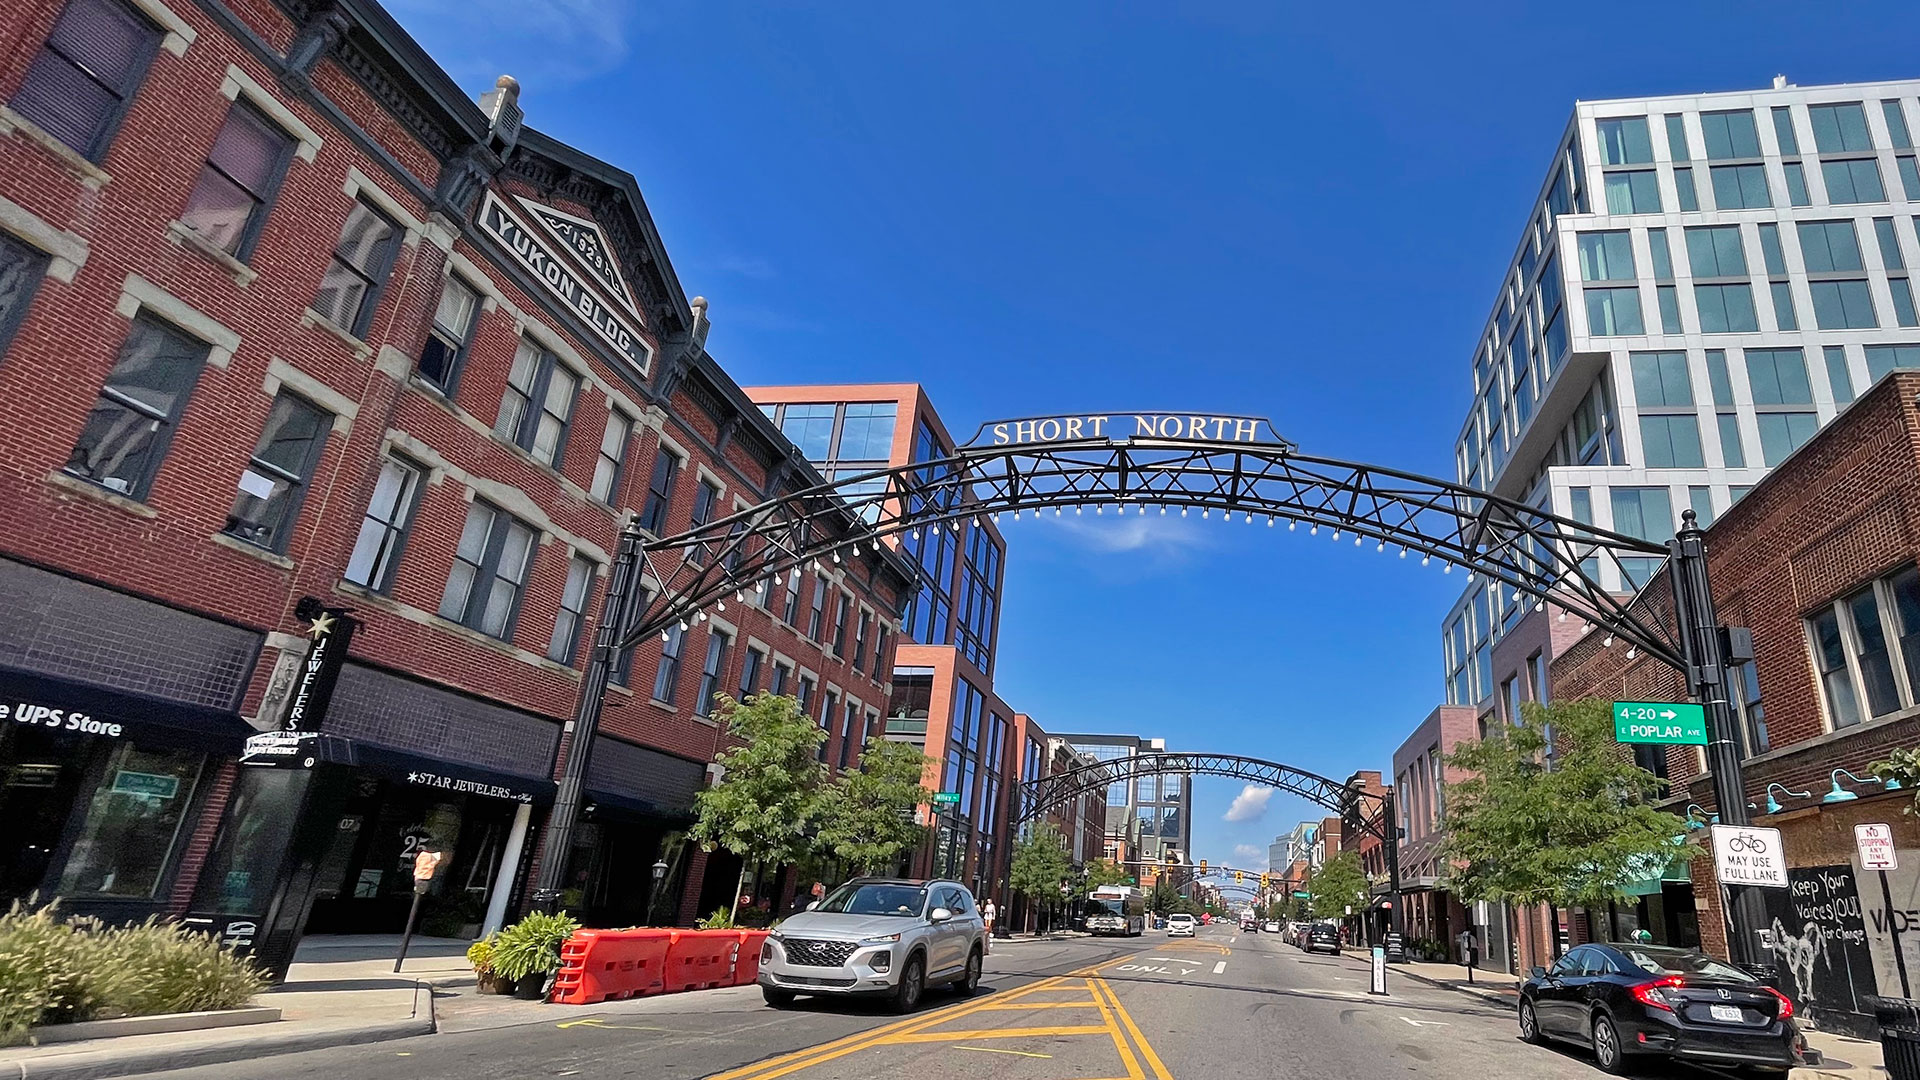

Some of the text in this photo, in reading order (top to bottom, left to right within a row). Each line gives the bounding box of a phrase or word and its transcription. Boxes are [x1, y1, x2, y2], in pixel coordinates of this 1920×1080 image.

[571, 231, 602, 269] 1929
[497, 210, 636, 358] YUKON BLDG.
[993, 415, 1259, 446] SHORT NORTH
[285, 637, 327, 731] JEWELERS
[14, 703, 64, 727] UPS
[65, 712, 122, 737] Store
[1620, 707, 1656, 720] 4-20
[1630, 725, 1682, 738] POPLAR
[417, 772, 452, 789] STAR
[453, 779, 511, 799] JEWELERS
[1865, 828, 1879, 838] NO
[1860, 837, 1889, 848] STOPPING
[1727, 855, 1772, 868] MAY USE
[1725, 868, 1779, 881] FULL LANE
[1791, 871, 1849, 902] Keep Your
[1795, 902, 1834, 920] Voices
[1116, 964, 1196, 976] ONLY
